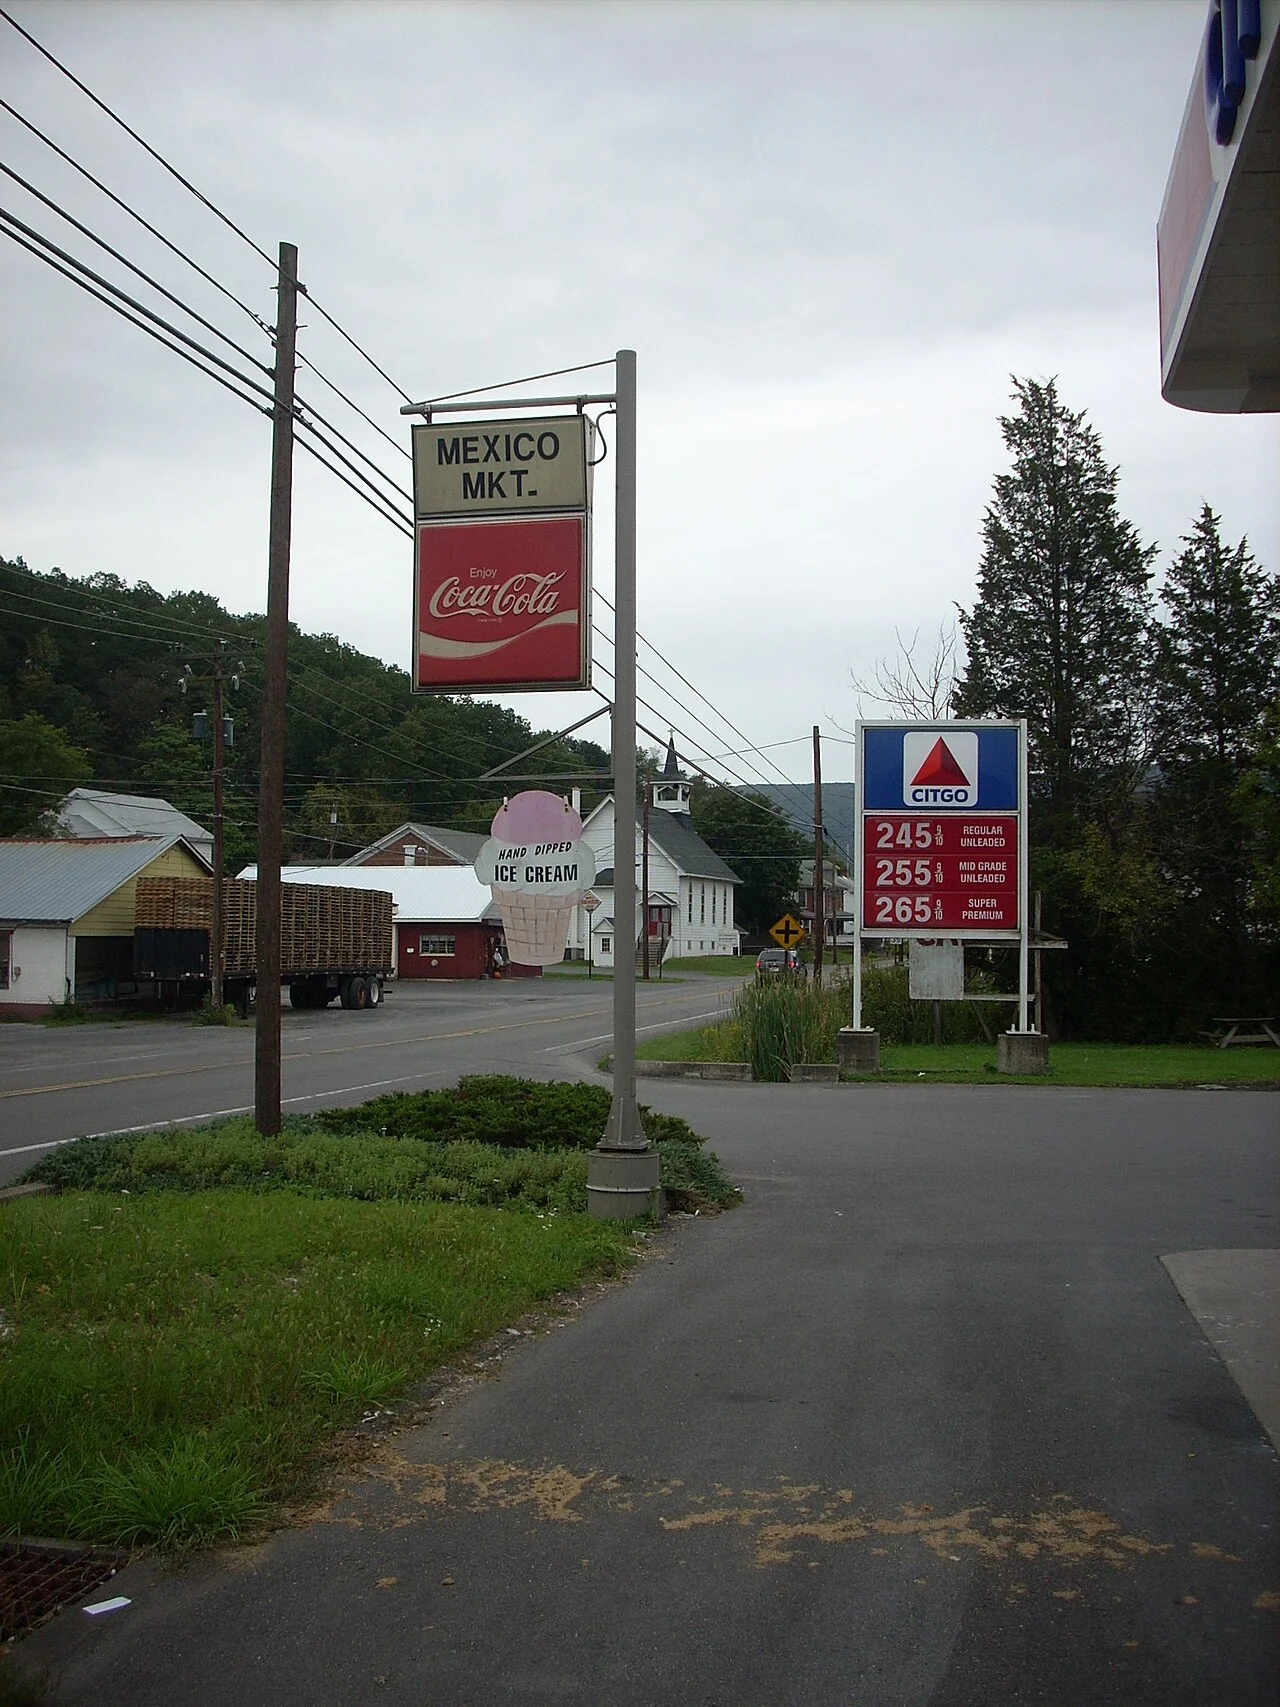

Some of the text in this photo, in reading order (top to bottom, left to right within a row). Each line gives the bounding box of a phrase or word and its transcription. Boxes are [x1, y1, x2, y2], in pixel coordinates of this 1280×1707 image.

[437, 432, 560, 466] MEXICO
[462, 469, 538, 500] MKT.
[469, 567, 498, 579] Enjoy
[428, 569, 568, 618] Coca-Cola
[911, 788, 969, 803] CITGO
[876, 822, 932, 848] 245
[963, 825, 1003, 835] REGULAR
[498, 841, 573, 861] HAND DIPPED
[960, 837, 1006, 848] UNLEADED
[494, 864, 578, 883] ICE CREAM
[876, 859, 931, 886] 255
[959, 862, 1007, 871] MID GRADE
[960, 873, 1006, 884] UNLEADED
[875, 896, 931, 923] 265
[968, 898, 997, 908] SUPER
[962, 910, 1003, 920] PREMIUM
